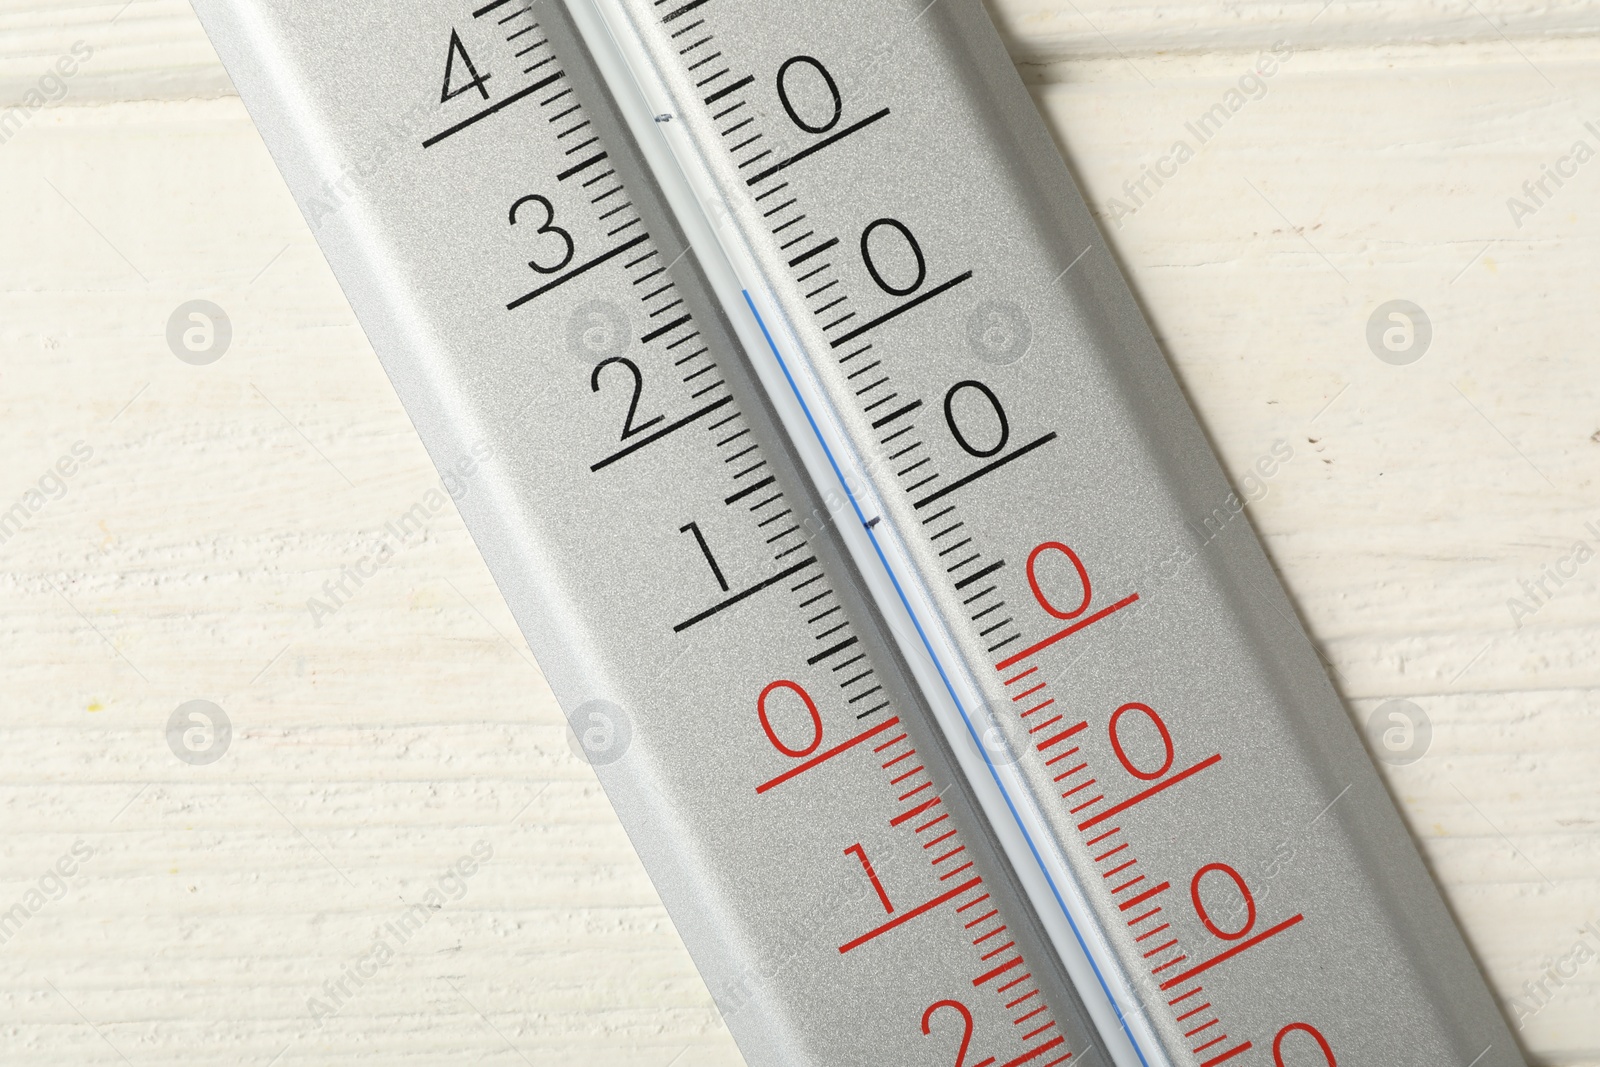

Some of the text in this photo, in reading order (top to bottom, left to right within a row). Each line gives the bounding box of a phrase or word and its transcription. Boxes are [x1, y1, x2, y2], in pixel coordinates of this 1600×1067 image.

[441, 28, 491, 103] 4
[777, 56, 842, 134] 0
[509, 195, 926, 296] 3 0
[591, 357, 1009, 458] 2 0
[680, 522, 729, 591] 1
[1026, 542, 1092, 620] 0
[758, 680, 1174, 780] 0 0
[844, 843, 894, 914] 1
[1191, 863, 1256, 940] 0
